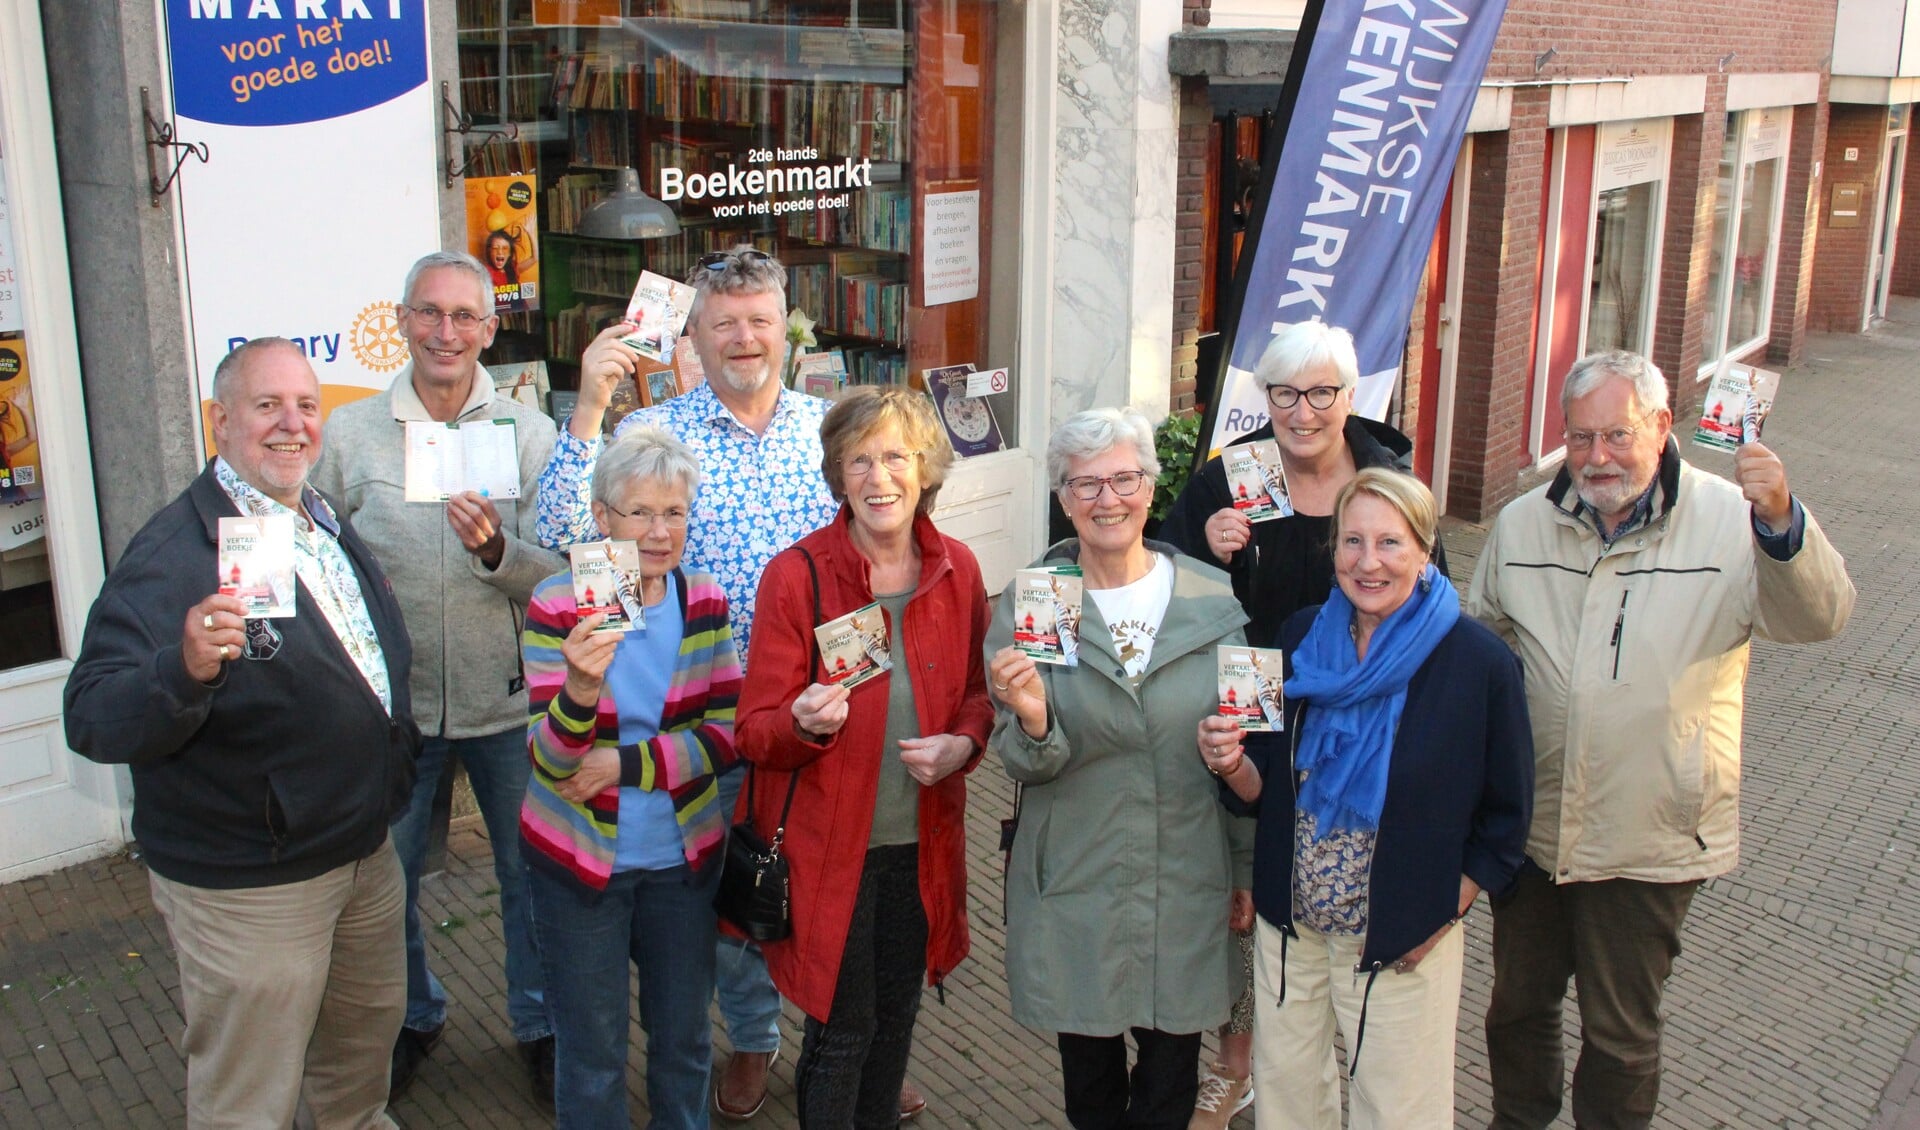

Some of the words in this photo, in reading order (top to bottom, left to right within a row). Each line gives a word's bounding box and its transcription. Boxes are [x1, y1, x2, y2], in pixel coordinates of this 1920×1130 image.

[220, 33, 286, 62] voor
[297, 17, 344, 48] het
[231, 57, 318, 102] goede
[327, 39, 392, 74] doel!
[748, 148, 773, 163] 2de
[777, 146, 818, 162] hands
[1847, 150, 1856, 158] 13
[660, 158, 872, 200] Boekenmarkt
[712, 204, 744, 218] voor
[748, 200, 770, 214] het
[774, 197, 814, 216] goede
[818, 194, 850, 210] doel!
[932, 226, 958, 236] afhalen
[959, 224, 971, 233] van
[940, 240, 964, 250] boeken
[228, 332, 340, 362] Rary
[1225, 408, 1271, 432] Rot
[1110, 620, 1156, 640] RAKLE
